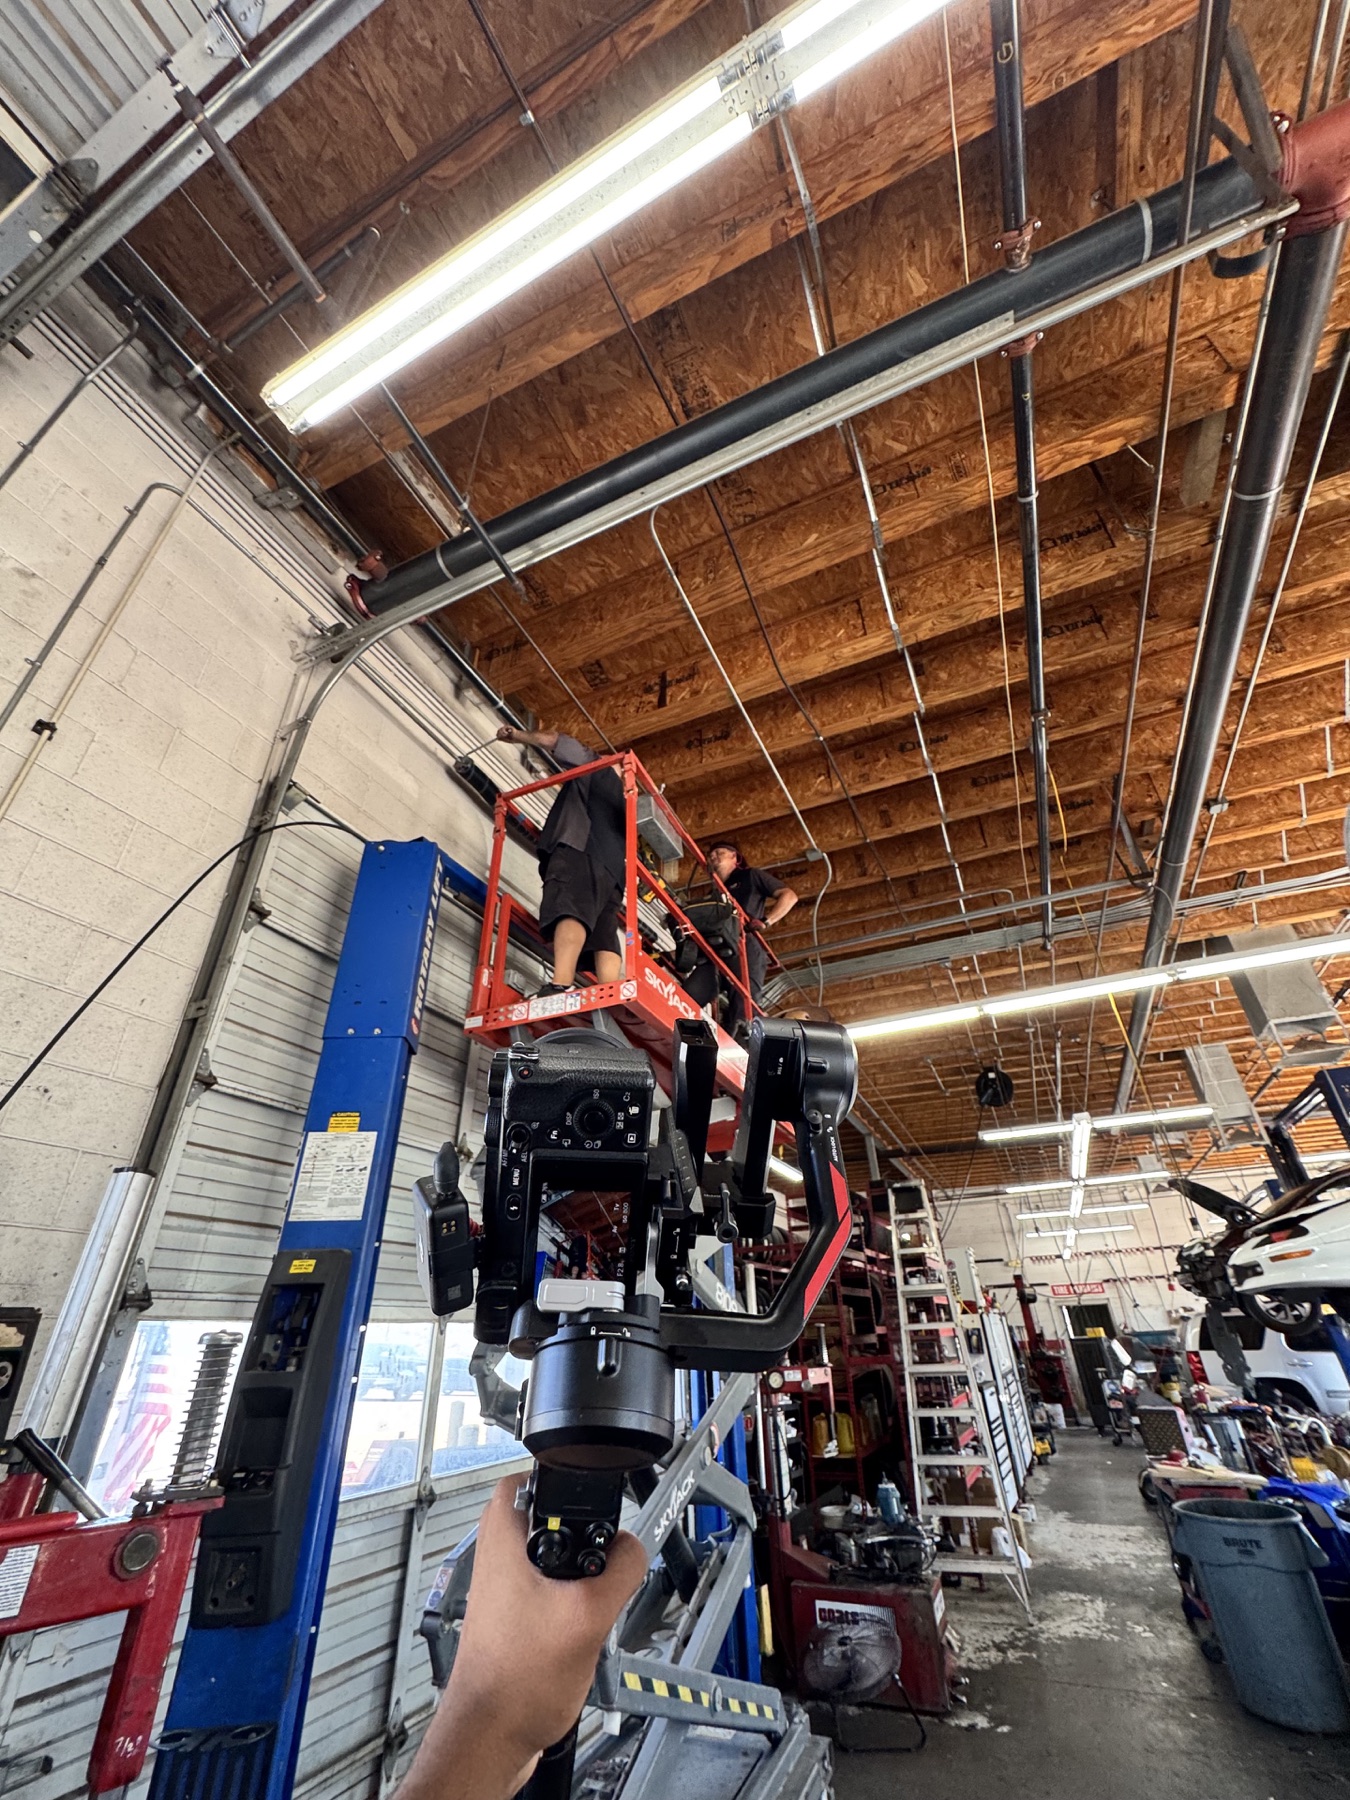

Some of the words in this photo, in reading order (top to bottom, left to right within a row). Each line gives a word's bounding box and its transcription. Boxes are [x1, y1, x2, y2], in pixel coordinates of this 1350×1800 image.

[414, 908, 434, 1020] ROTARY
[431, 854, 443, 909] LIFT
[644, 967, 696, 1019] SKYJACK
[550, 1130, 558, 1139] Fn
[512, 1168, 520, 1186] MENU
[595, 1536, 605, 1544] M
